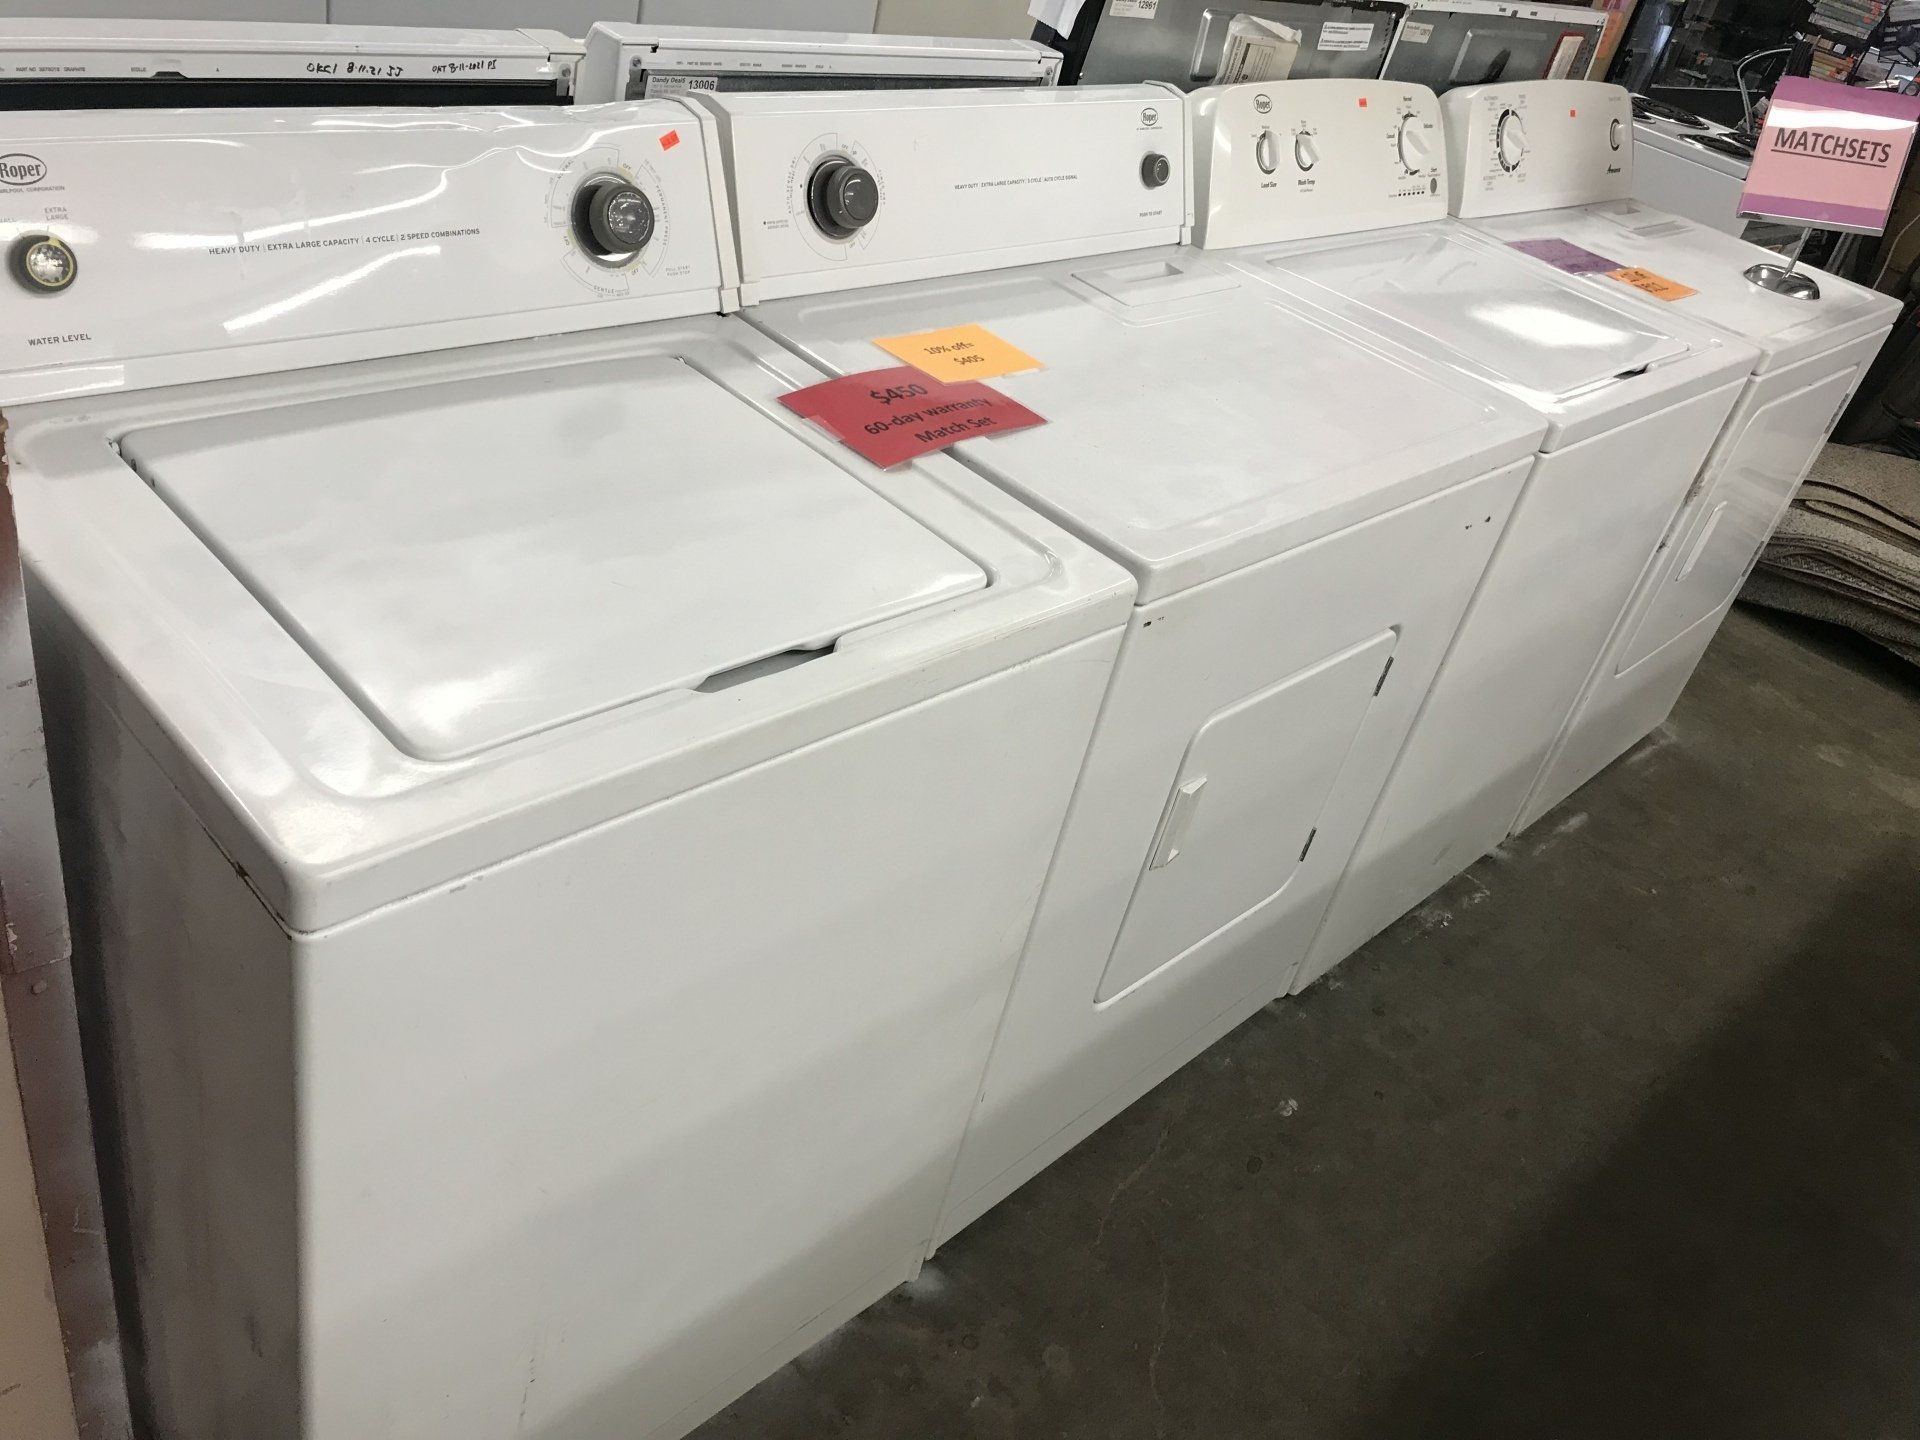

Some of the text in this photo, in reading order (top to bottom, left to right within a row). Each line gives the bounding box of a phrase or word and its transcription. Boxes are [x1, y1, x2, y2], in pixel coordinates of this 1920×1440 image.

[689, 80, 715, 90] 13006
[1774, 127, 1892, 163] MATCHSETS
[0, 162, 41, 180] Roper
[267, 243, 294, 251] EXTRA
[295, 240, 322, 249] LARGE
[322, 238, 360, 248] CAPACITY
[431, 228, 480, 239] COMBINATIONS
[28, 333, 92, 346] WATER LEVEL
[924, 345, 950, 355] 10%
[953, 354, 984, 366] $405
[870, 383, 928, 406] $450
[864, 396, 992, 436] 60-day warranty
[914, 416, 998, 444] Match Set
